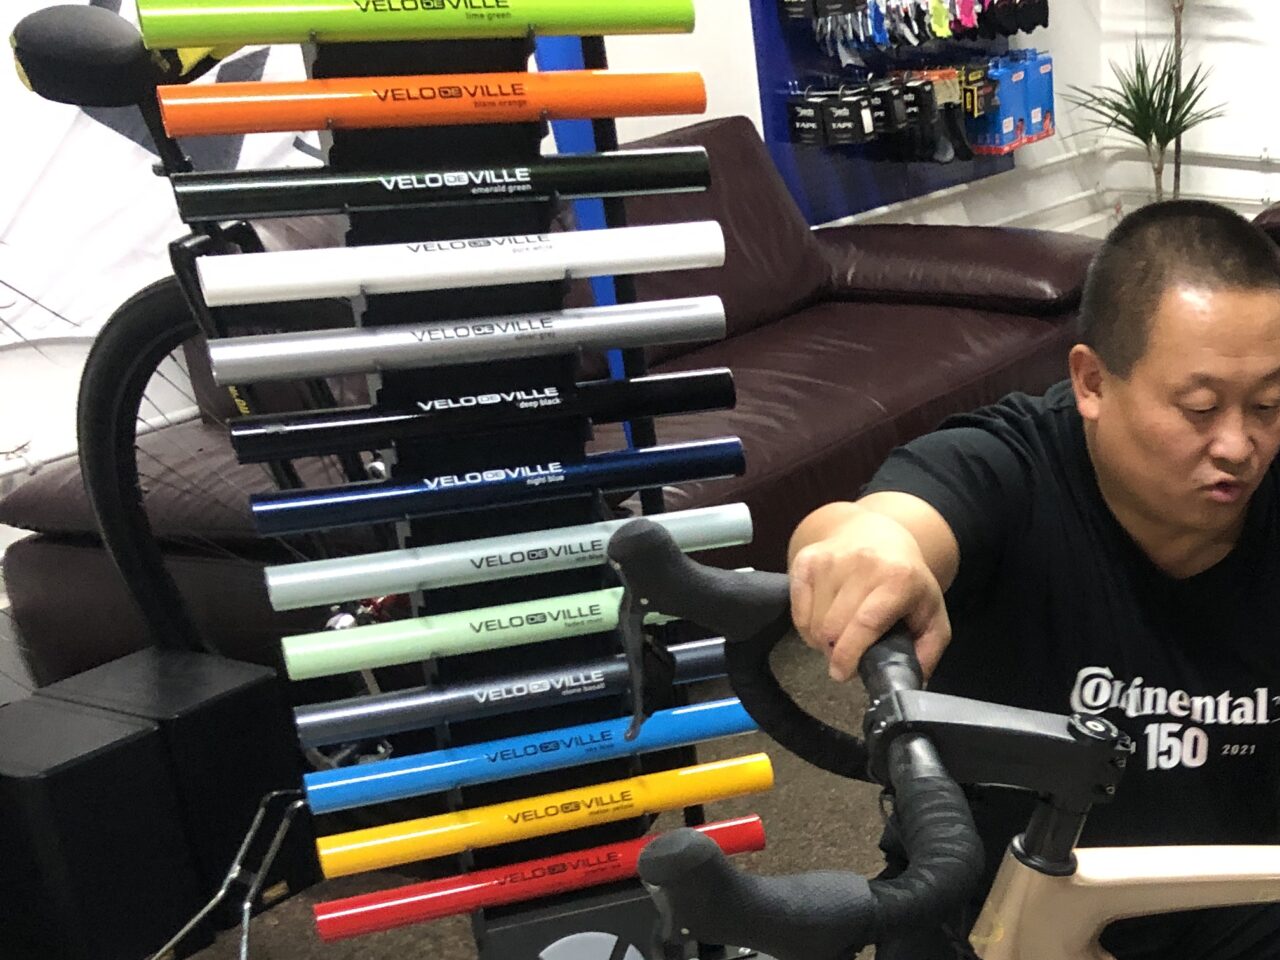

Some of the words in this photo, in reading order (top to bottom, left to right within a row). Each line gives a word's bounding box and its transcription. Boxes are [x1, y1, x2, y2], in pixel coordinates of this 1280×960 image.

[508, 183, 532, 193] green
[519, 399, 538, 409] deep
[540, 397, 562, 407] black
[1070, 665, 1269, 725] Coninental
[1144, 722, 1209, 770] 150
[1221, 743, 1256, 756] 2021
